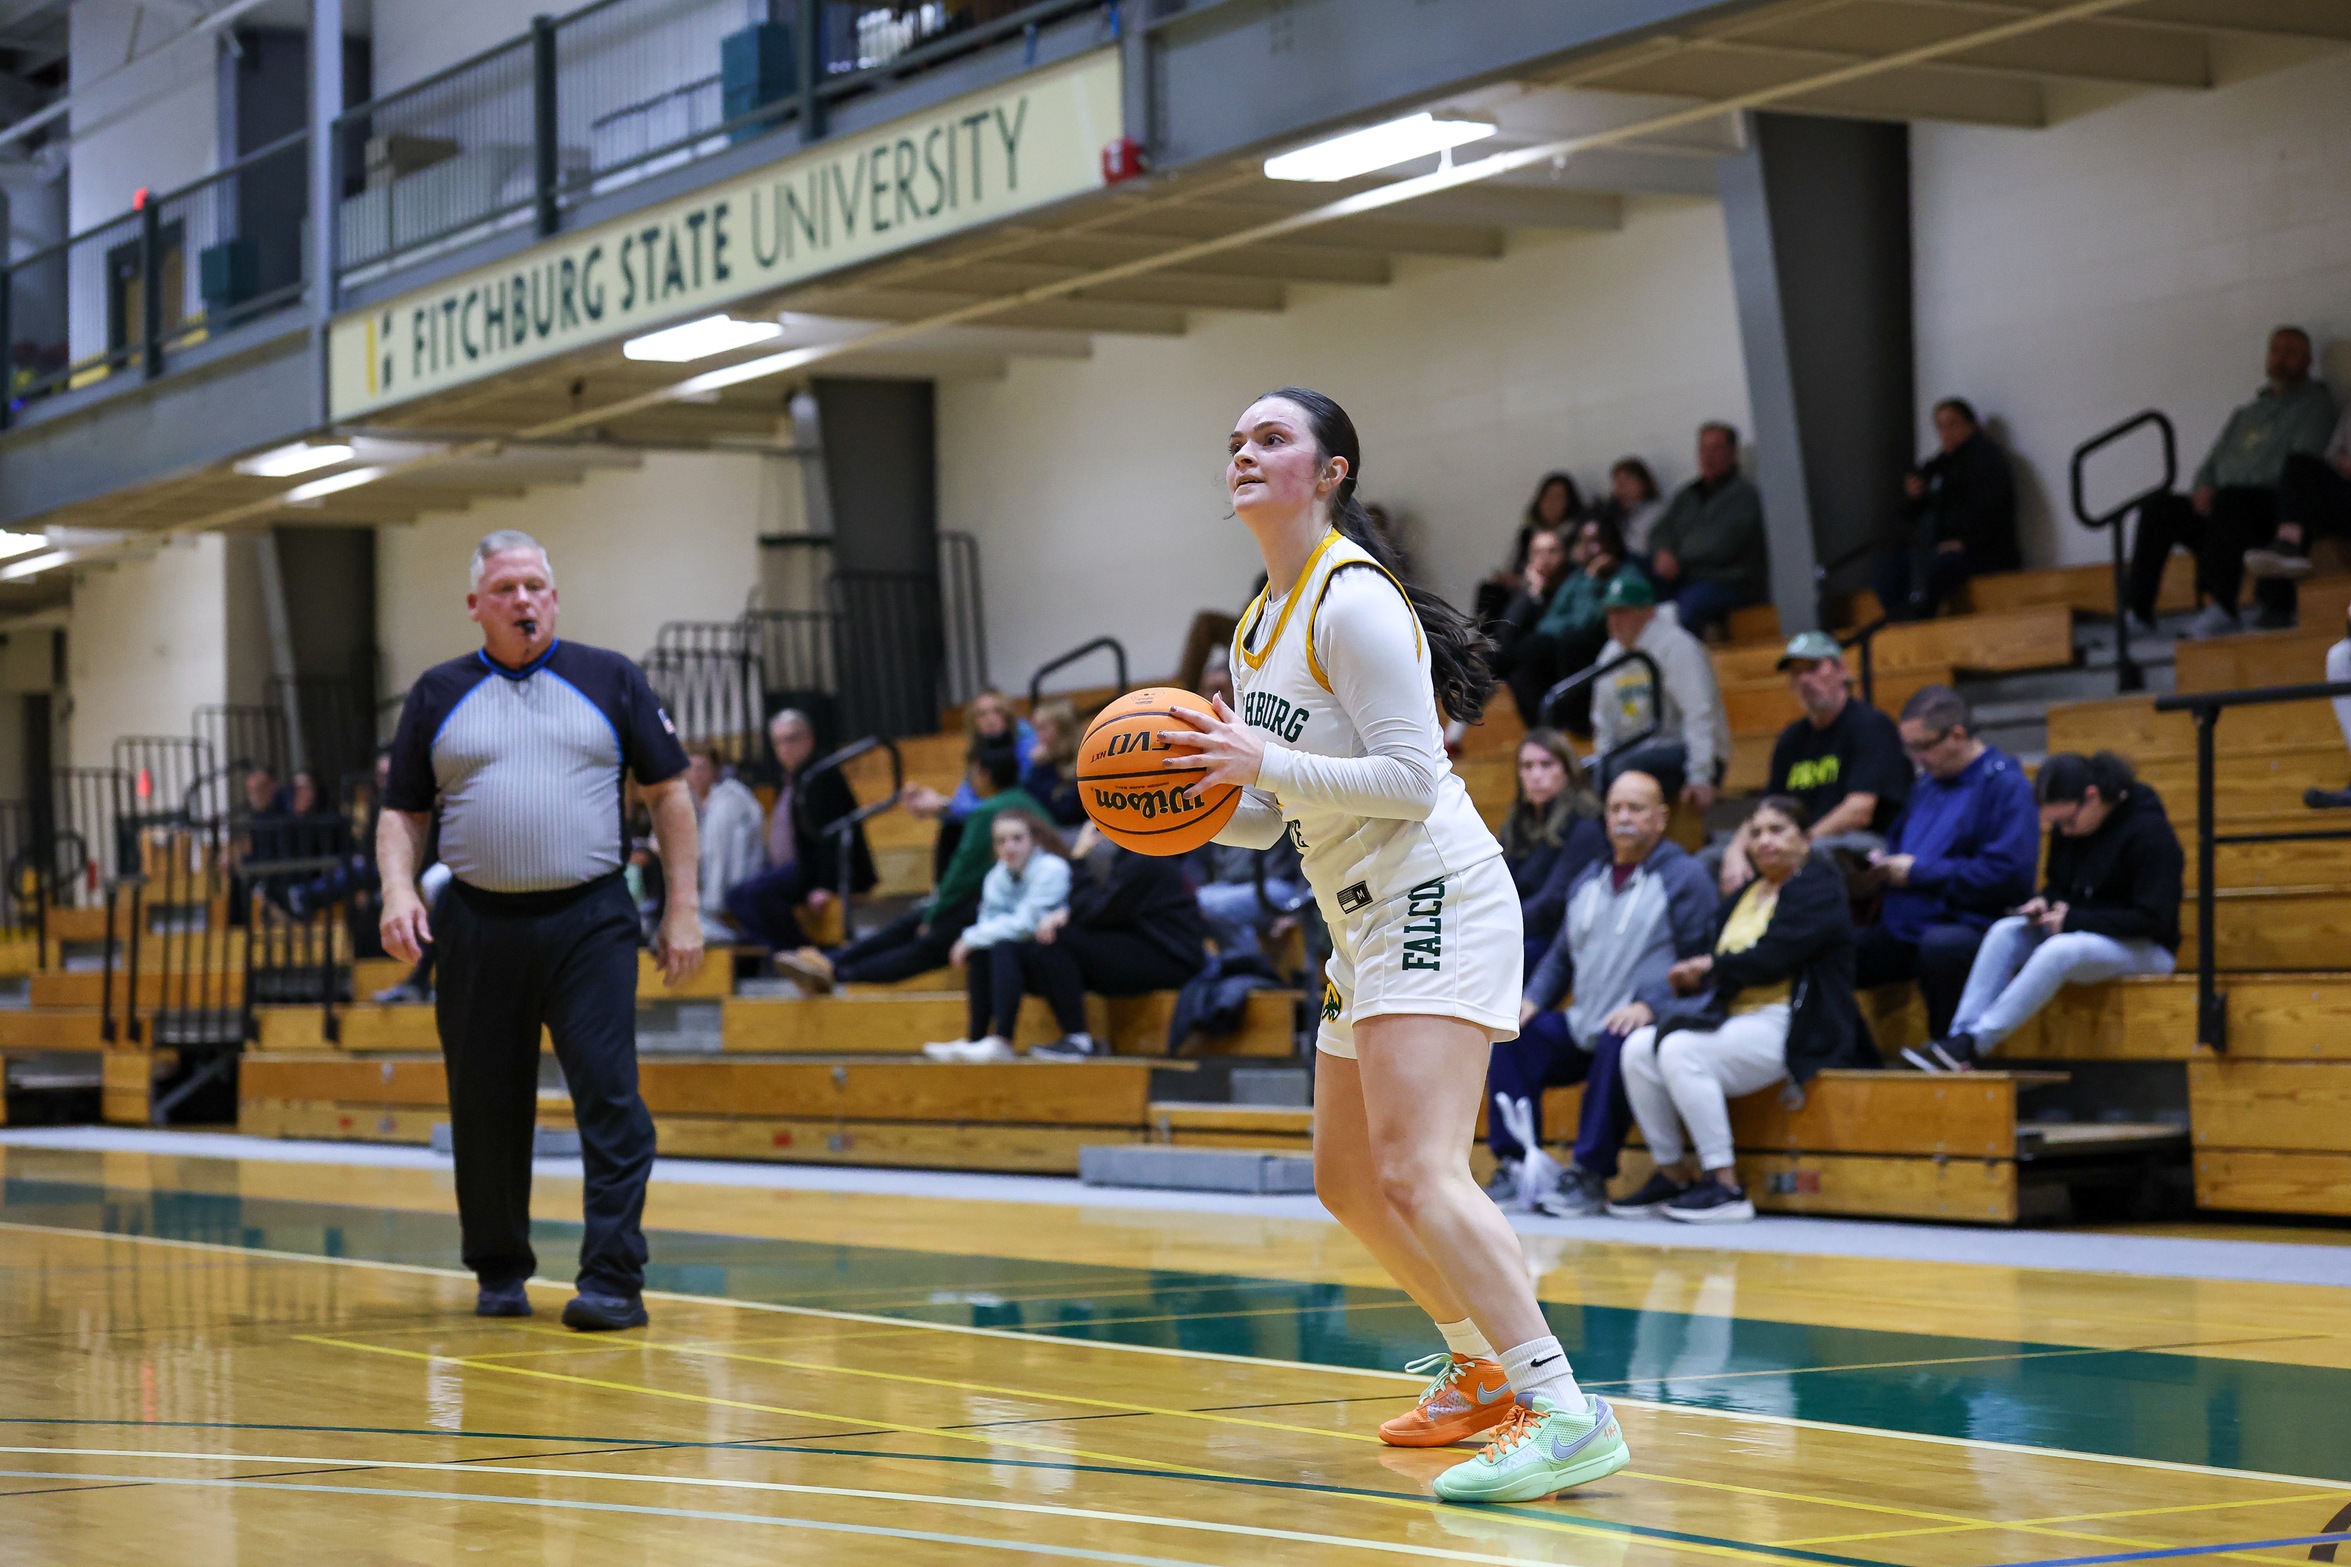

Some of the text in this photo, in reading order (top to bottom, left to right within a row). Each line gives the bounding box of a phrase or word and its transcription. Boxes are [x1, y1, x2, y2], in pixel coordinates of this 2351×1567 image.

[412, 97, 1028, 377] FITCHBURG STATE UNIVERSITY
[1243, 691, 1310, 743] HBURG
[1090, 750, 1107, 763] NXT
[1094, 781, 1205, 819] Wilson
[1356, 889, 1365, 900] M
[1402, 875, 1445, 971] FALCO
